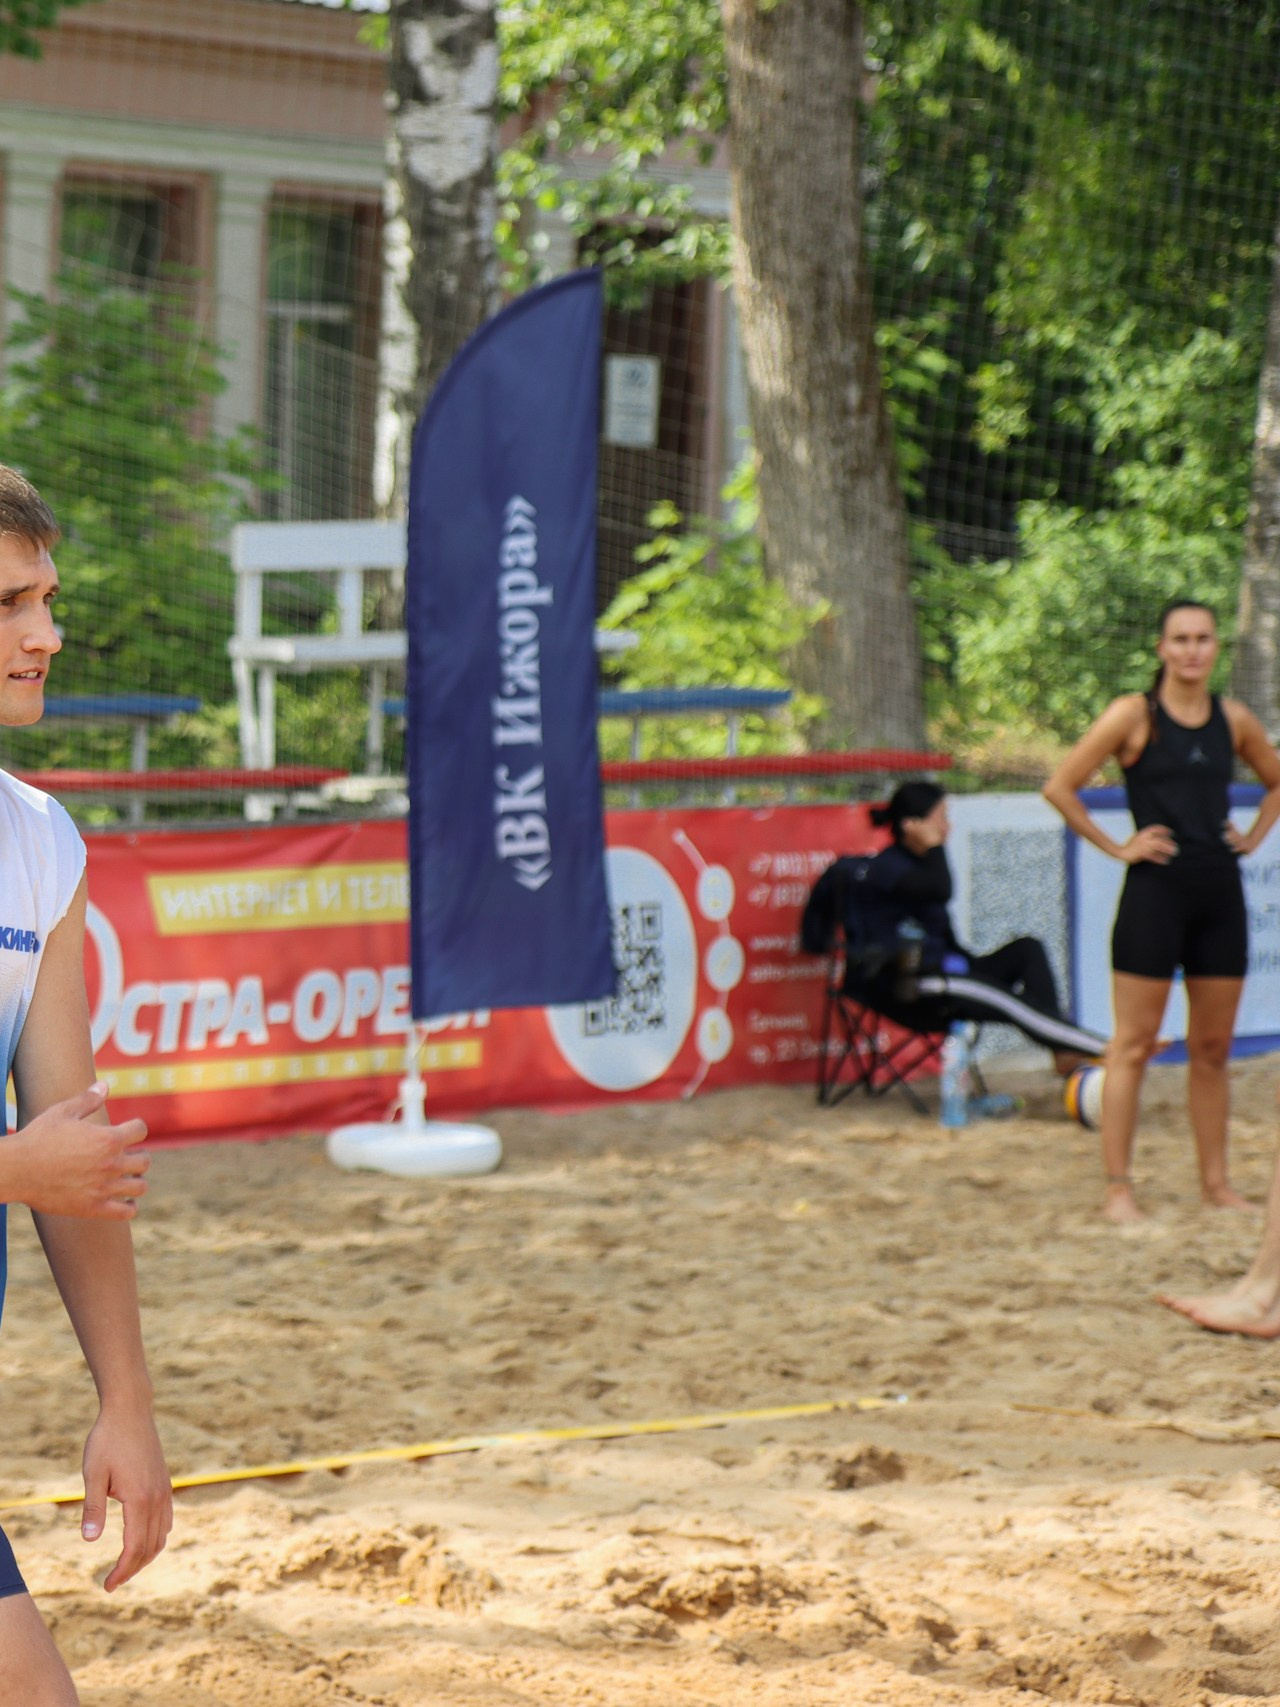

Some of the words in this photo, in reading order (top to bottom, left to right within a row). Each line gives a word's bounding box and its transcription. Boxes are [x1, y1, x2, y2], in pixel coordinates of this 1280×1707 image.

[491, 495, 553, 746] Ижора»
[494, 762, 552, 891] «ВК
[160, 879, 309, 920] ИНТЕРНЕТ
[317, 878, 341, 912] И
